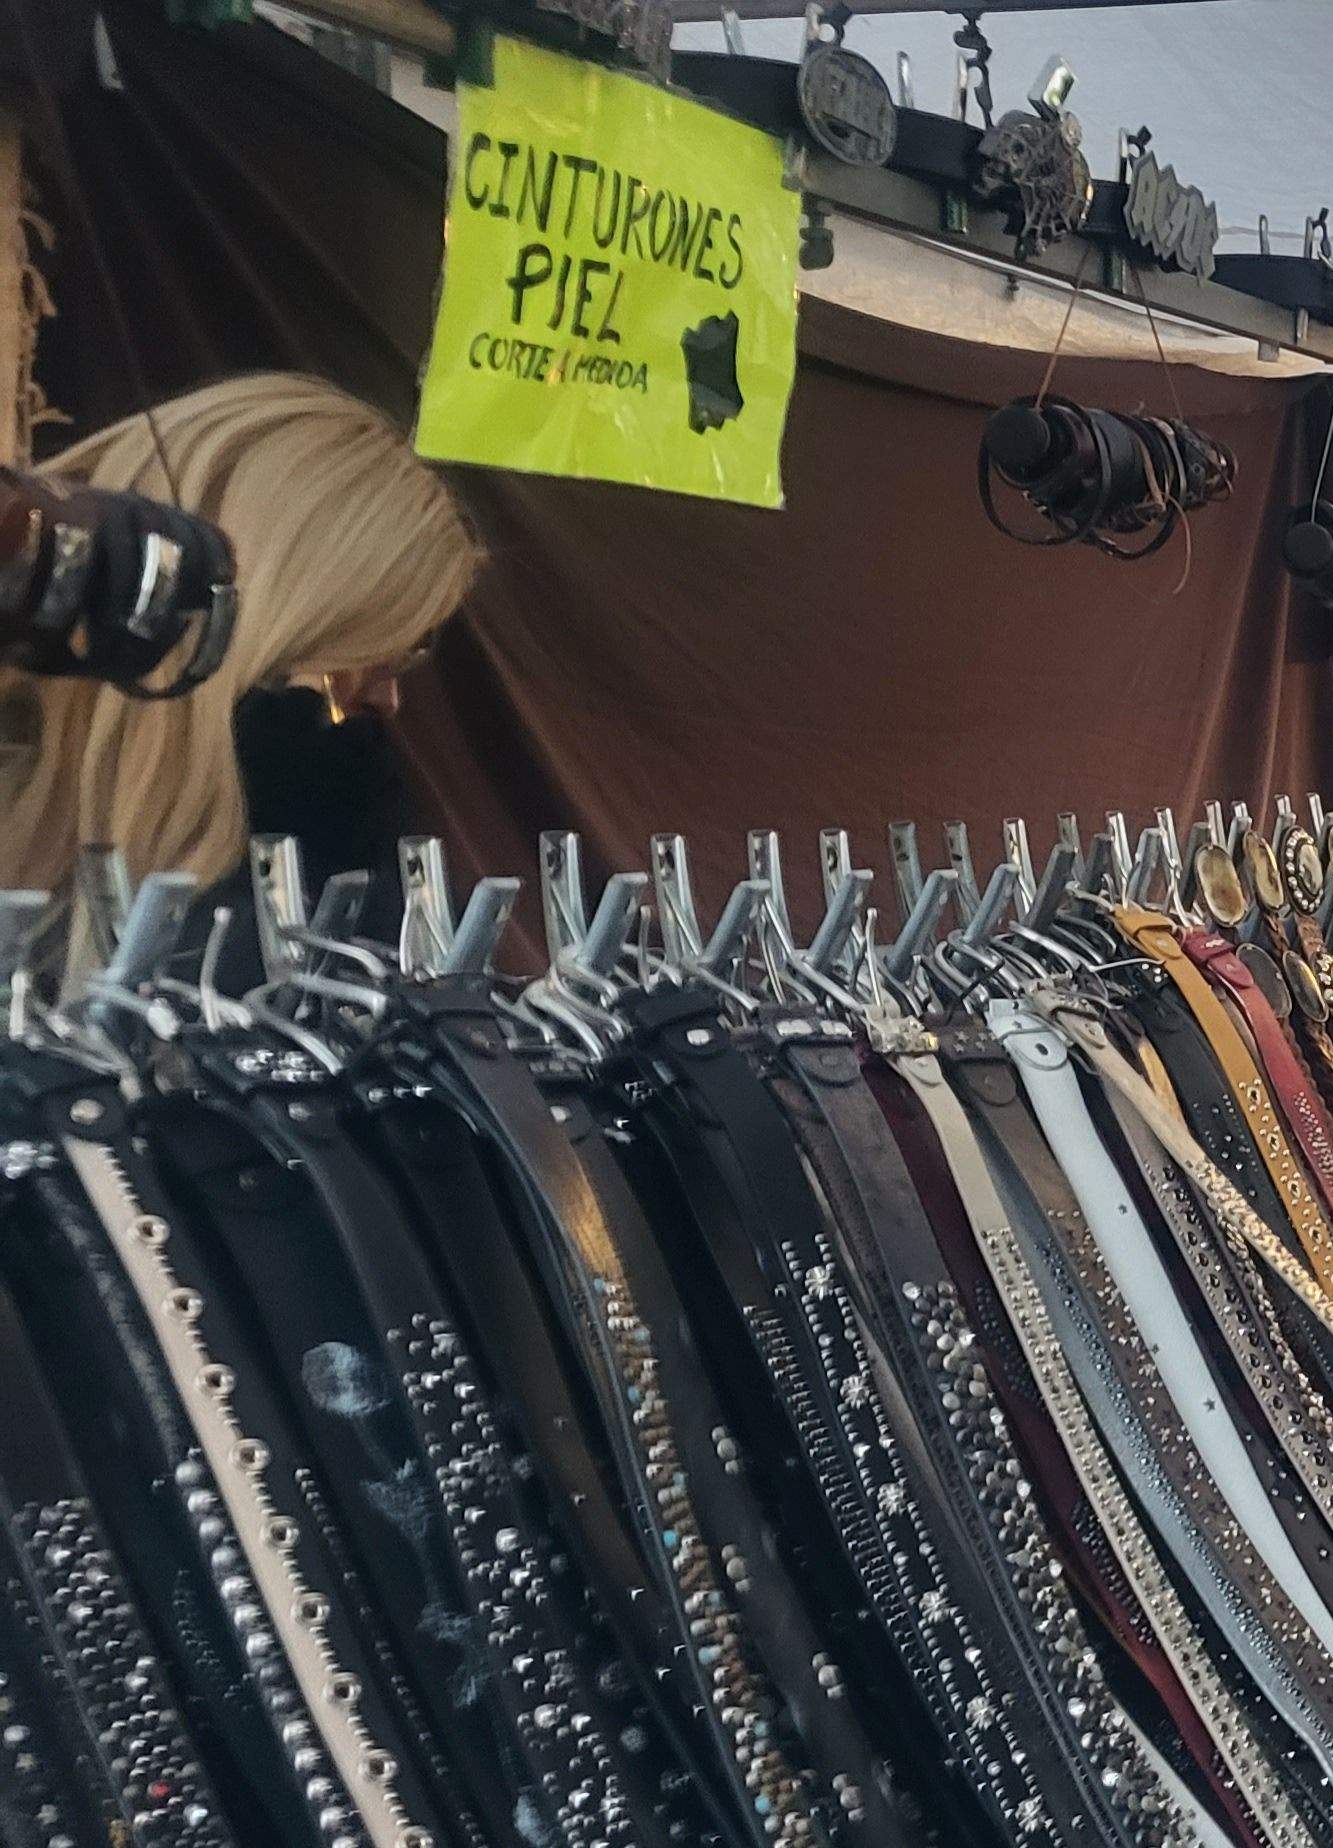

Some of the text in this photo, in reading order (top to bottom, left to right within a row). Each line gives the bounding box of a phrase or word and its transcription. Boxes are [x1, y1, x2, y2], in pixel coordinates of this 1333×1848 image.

[465, 131, 743, 290] CINTURONES
[506, 243, 622, 345] PIEL
[469, 332, 554, 382] CORTE
